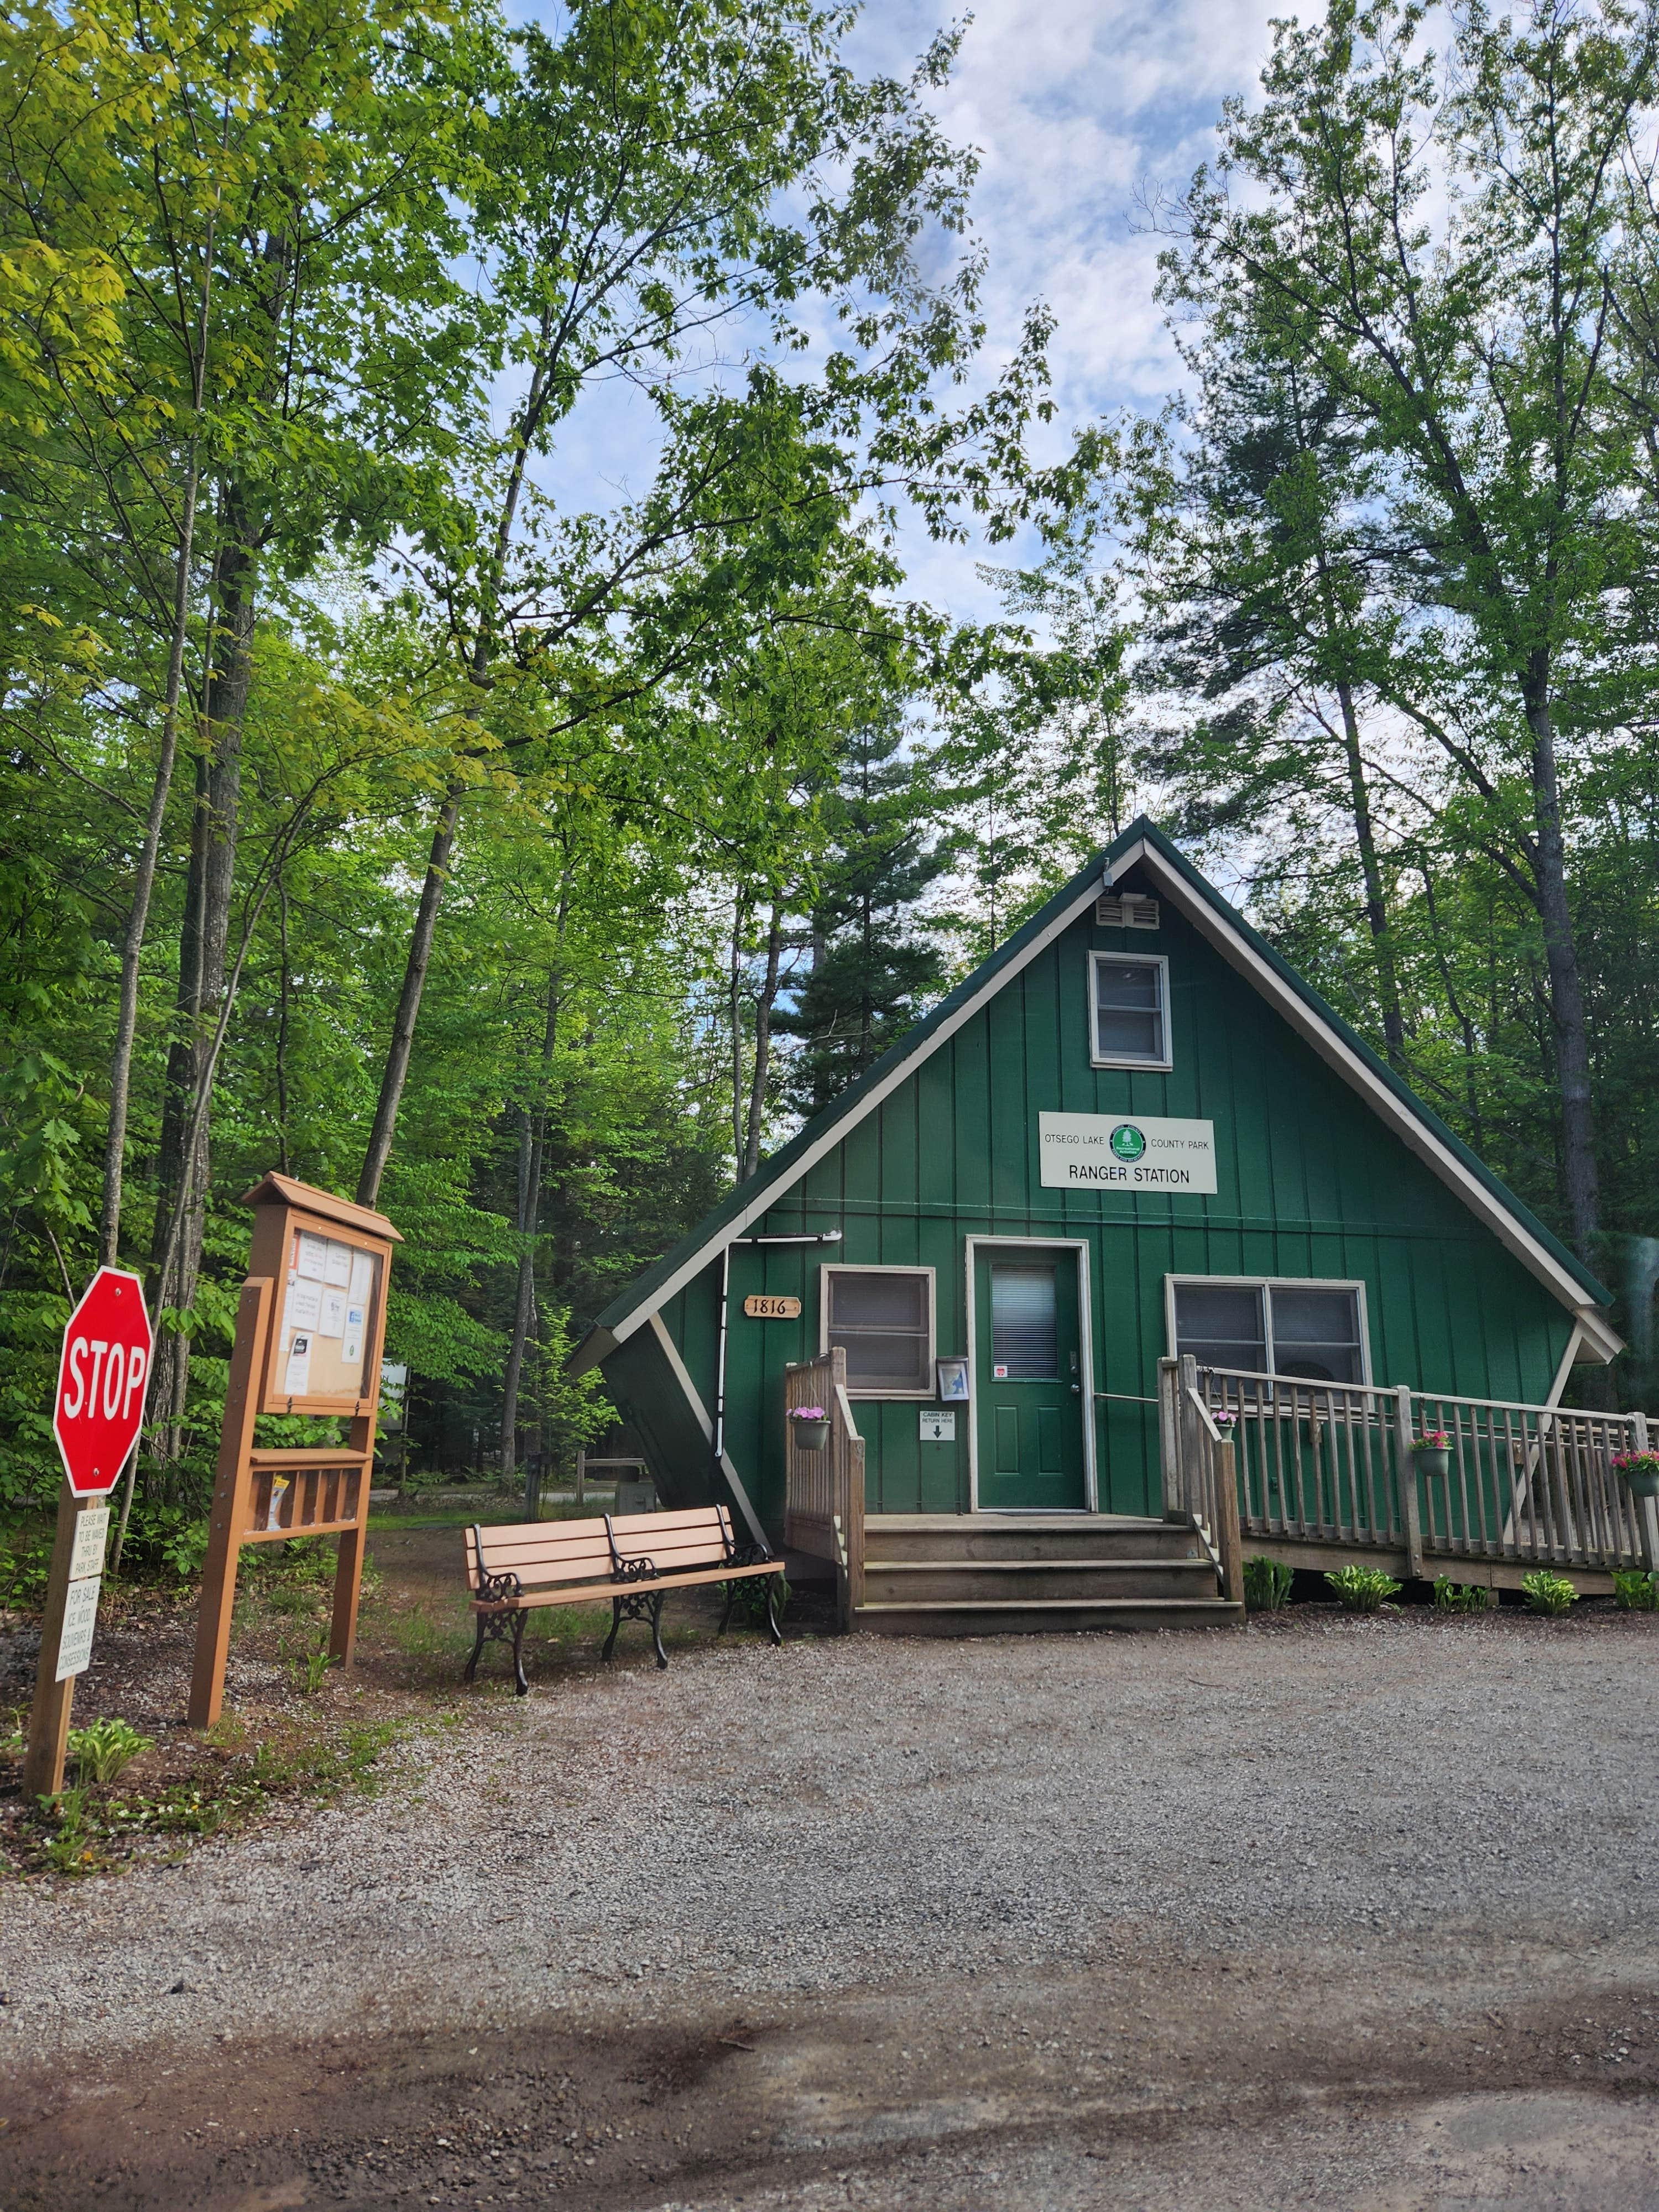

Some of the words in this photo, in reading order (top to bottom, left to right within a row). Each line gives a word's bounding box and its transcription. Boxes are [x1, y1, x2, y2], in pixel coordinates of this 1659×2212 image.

[1045, 1134, 1079, 1145] OTSEGO
[1083, 1135, 1104, 1145] LAKE
[1151, 1139, 1185, 1150] COUNTY
[1188, 1141, 1209, 1150] PARK
[1069, 1165, 1127, 1181] RANGER
[1134, 1168, 1190, 1183] STATION
[753, 1298, 786, 1315] 1816
[64, 1337, 146, 1421] STOP
[80, 1513, 96, 1527] PLEASE
[79, 1531, 84, 1543] TO
[85, 1530, 91, 1542] BE
[81, 1545, 92, 1558] THRU
[92, 1543, 99, 1556] BY
[86, 1558, 100, 1572] STAFF
[69, 1588, 82, 1606] FOR
[82, 1585, 96, 1603] SALE
